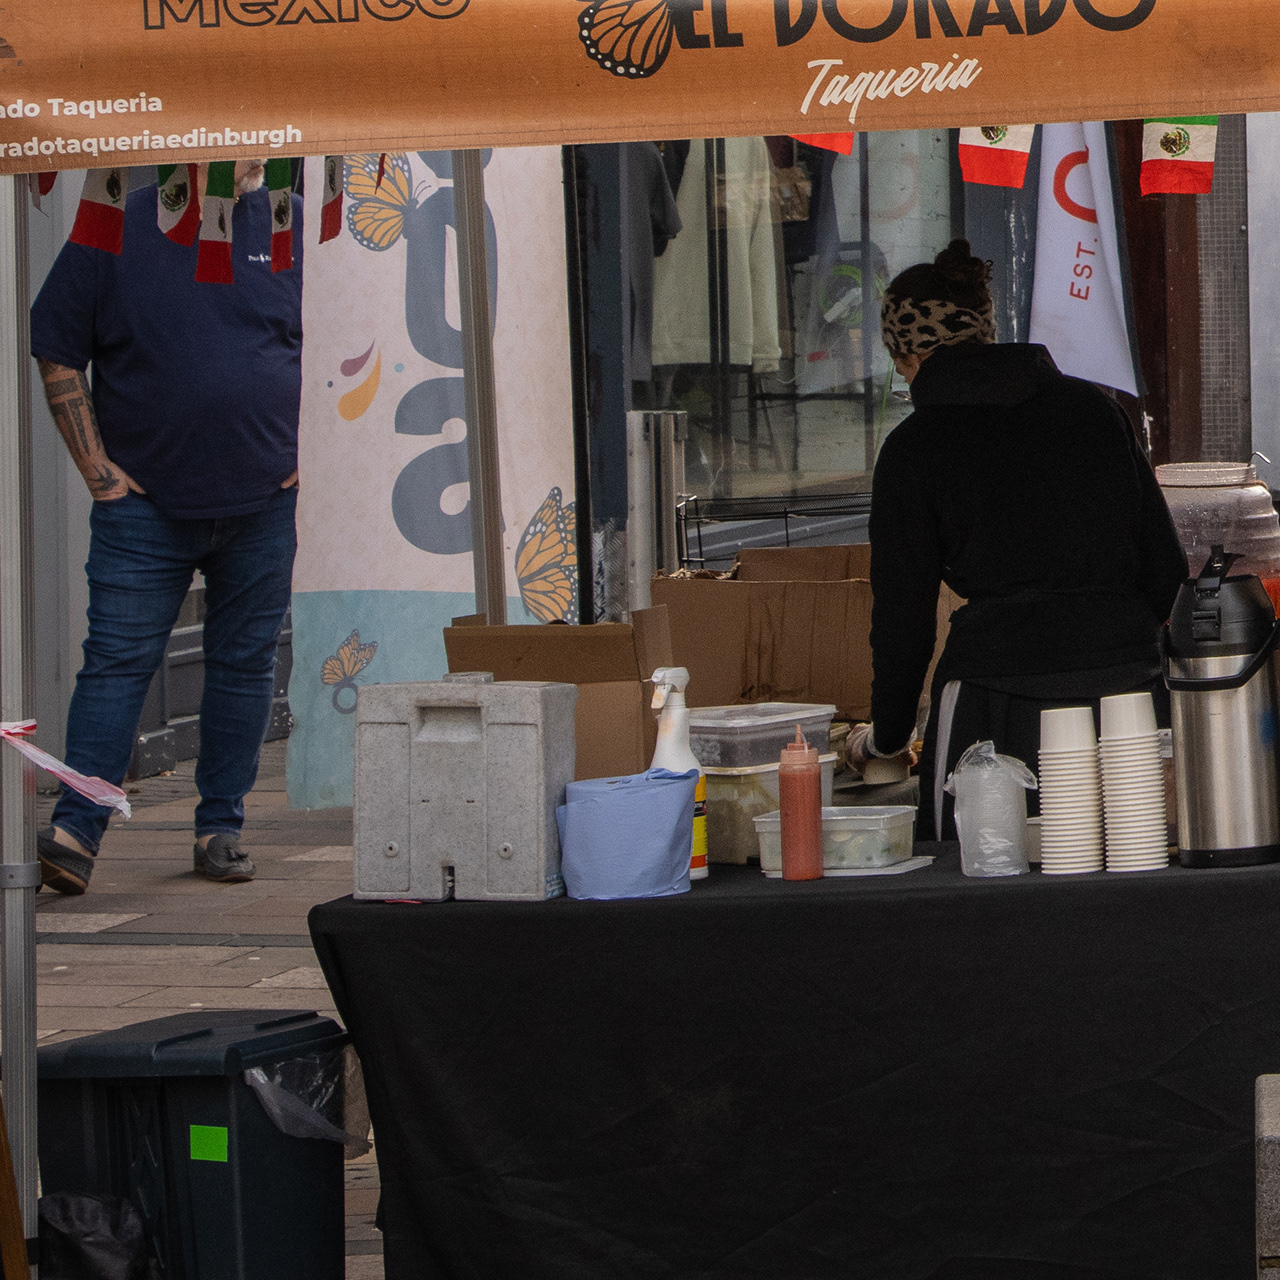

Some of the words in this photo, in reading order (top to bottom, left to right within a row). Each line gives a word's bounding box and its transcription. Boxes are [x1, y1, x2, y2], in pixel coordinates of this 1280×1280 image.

[47, 92, 163, 119] Taqueria
[801, 53, 983, 124] Taqueria
[1069, 238, 1098, 301] EST.
